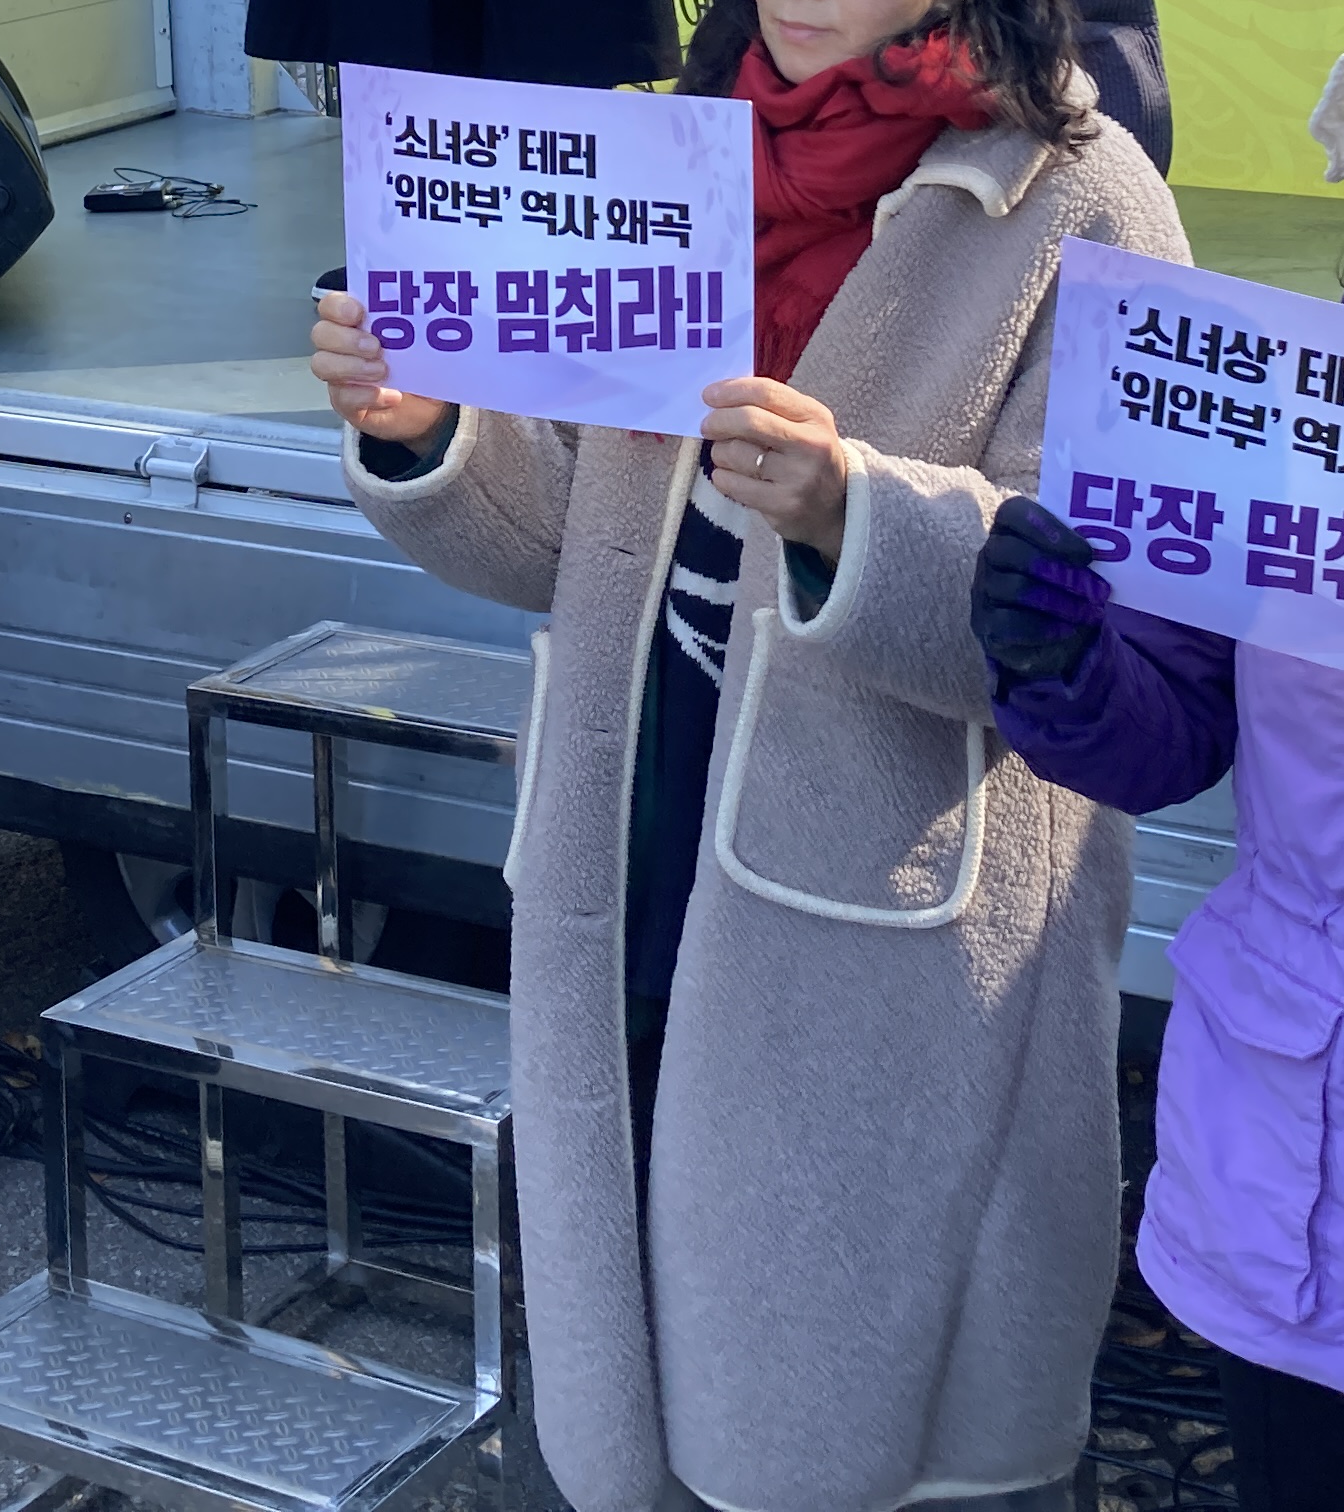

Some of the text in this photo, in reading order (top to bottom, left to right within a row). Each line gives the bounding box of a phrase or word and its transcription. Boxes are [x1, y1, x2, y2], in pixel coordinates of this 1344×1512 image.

[518, 128, 597, 179] 테러
[521, 189, 599, 241] 역사
[606, 197, 693, 249] 왜곡
[367, 265, 723, 354] 당장 멈춰라!!
[1069, 471, 1225, 576] 당장
